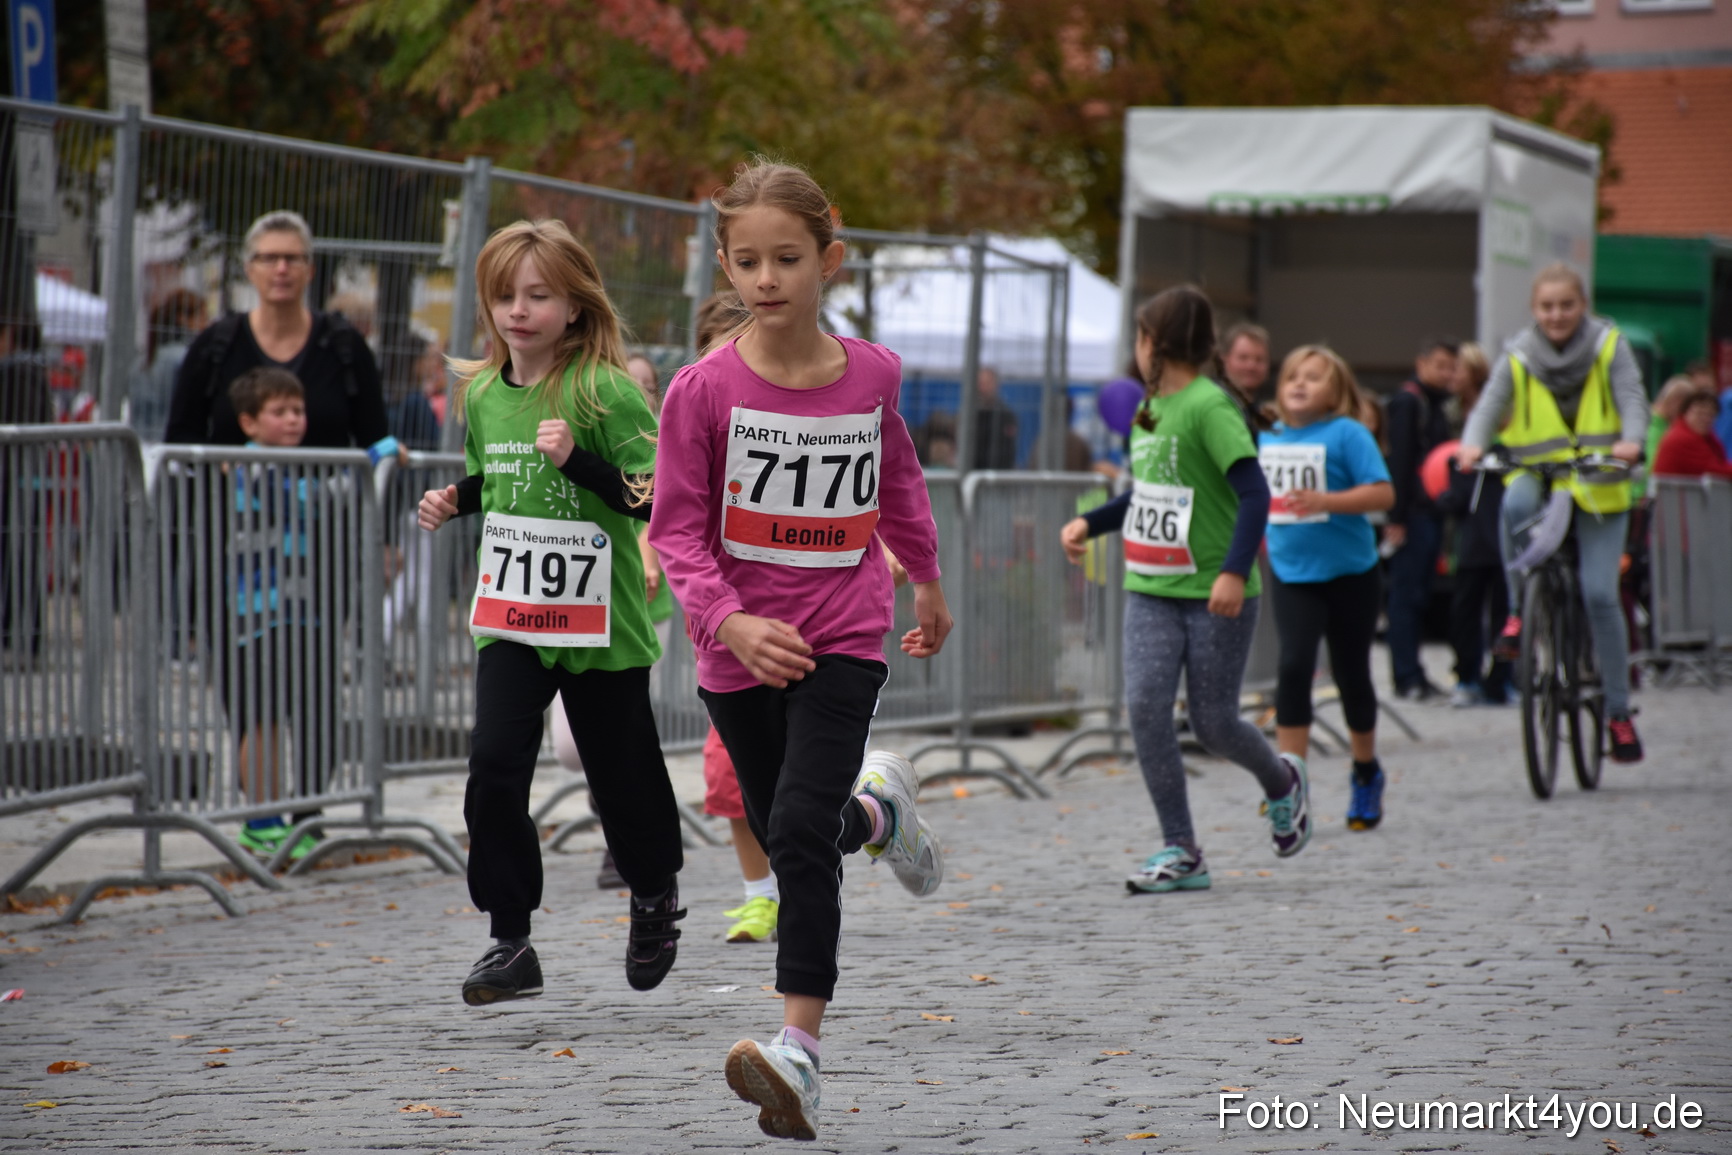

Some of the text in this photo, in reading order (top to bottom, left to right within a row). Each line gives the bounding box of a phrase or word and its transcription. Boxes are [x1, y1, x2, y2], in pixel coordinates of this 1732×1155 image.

[19, 4, 45, 99] P
[734, 424, 872, 446] PARTL Neumarkt
[747, 449, 875, 509] 7170
[486, 525, 586, 546] PARTL Neumarkt
[771, 522, 846, 546] Leonie
[493, 546, 597, 598] 7197
[506, 607, 569, 628] Carolin
